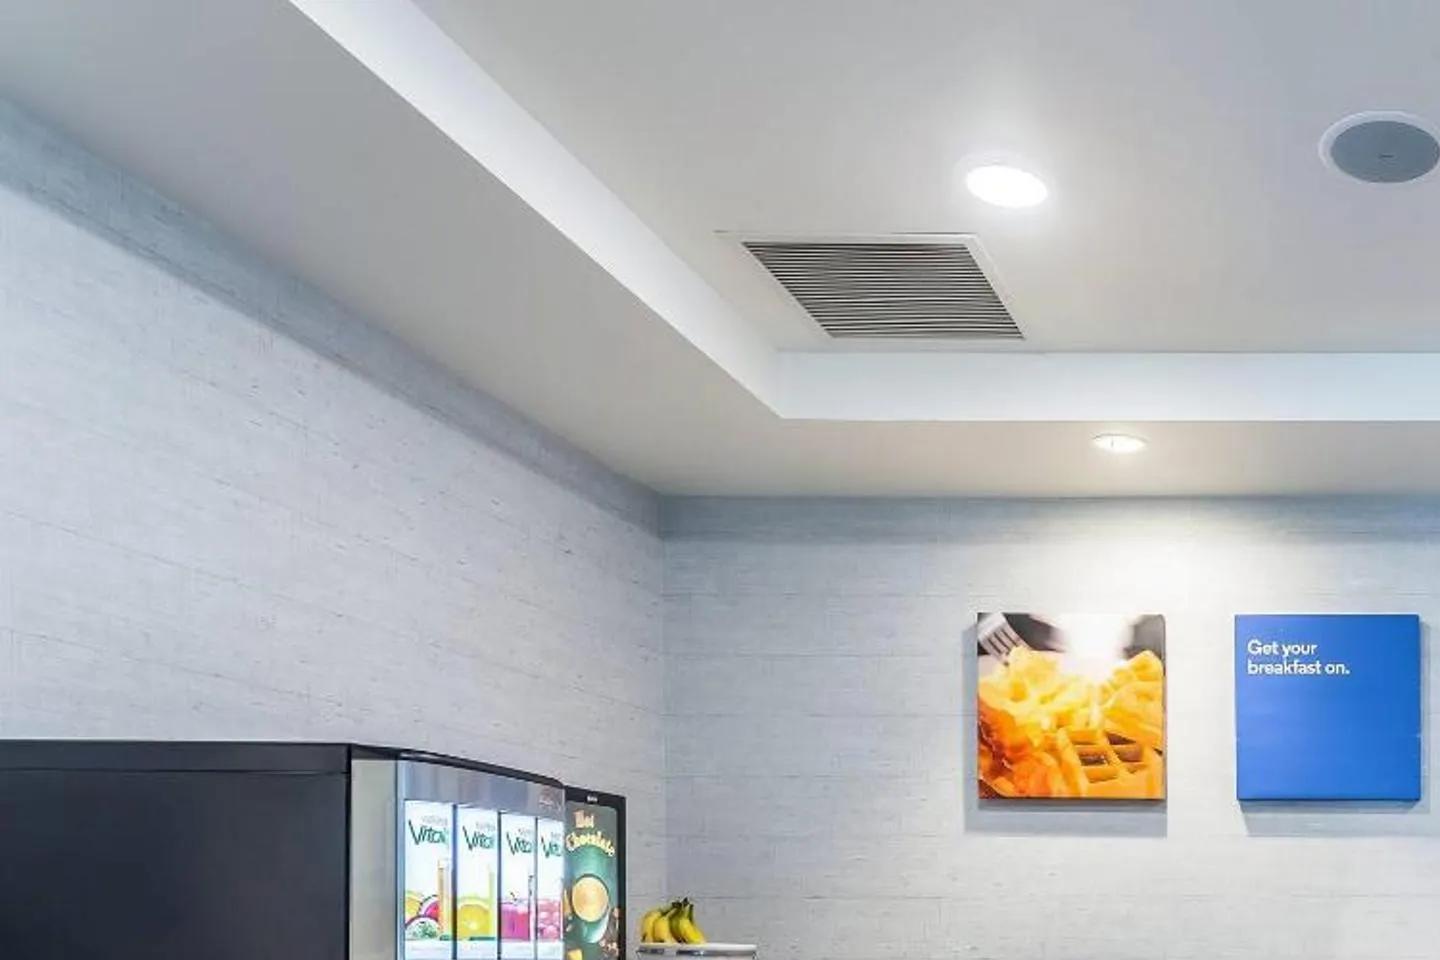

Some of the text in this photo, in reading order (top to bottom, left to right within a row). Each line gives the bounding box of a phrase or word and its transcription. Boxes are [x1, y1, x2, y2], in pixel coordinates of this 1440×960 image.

[1247, 639, 1318, 658] Get your
[1247, 660, 1351, 675] breakfast on.
